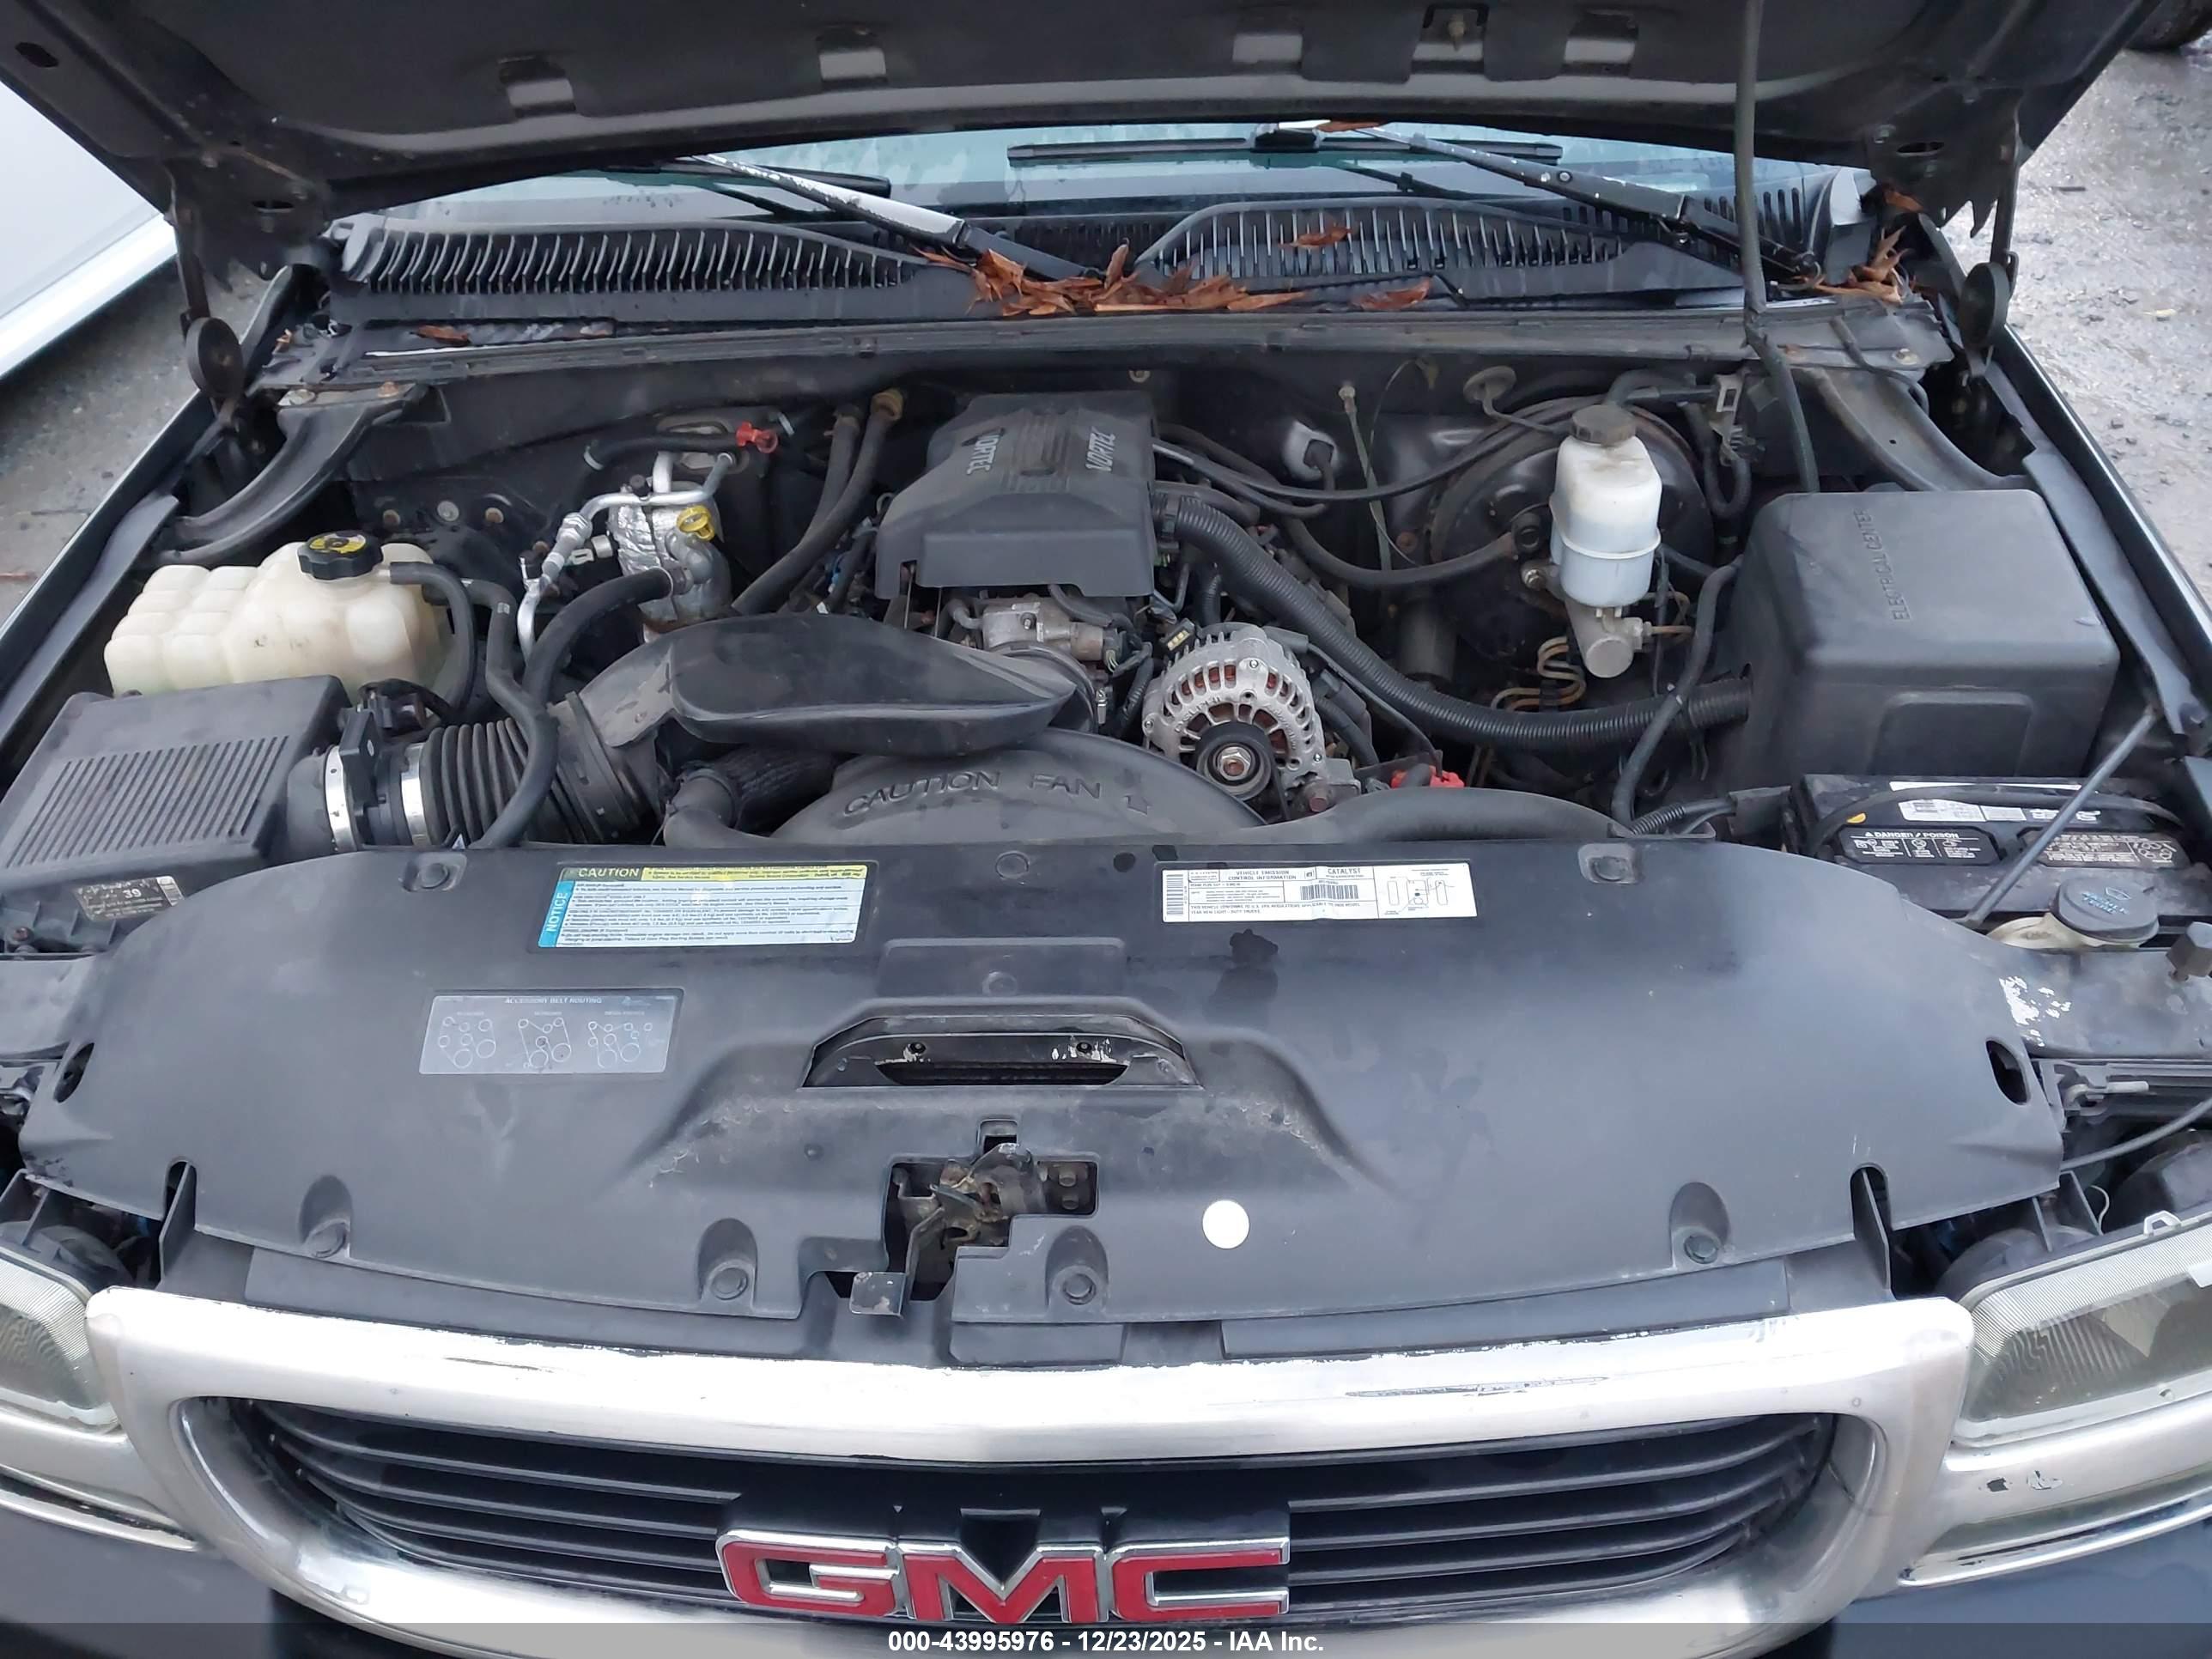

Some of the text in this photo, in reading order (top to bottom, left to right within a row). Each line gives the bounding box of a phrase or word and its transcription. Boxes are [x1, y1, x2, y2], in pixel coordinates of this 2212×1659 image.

[1085, 425, 1116, 472] VORTEC
[842, 769, 1101, 817] CAUTION FAN
[122, 888, 142, 899] 39
[578, 867, 640, 878] CAUTION
[546, 891, 568, 933] NOTICE
[715, 1528, 1291, 1625] GMC
